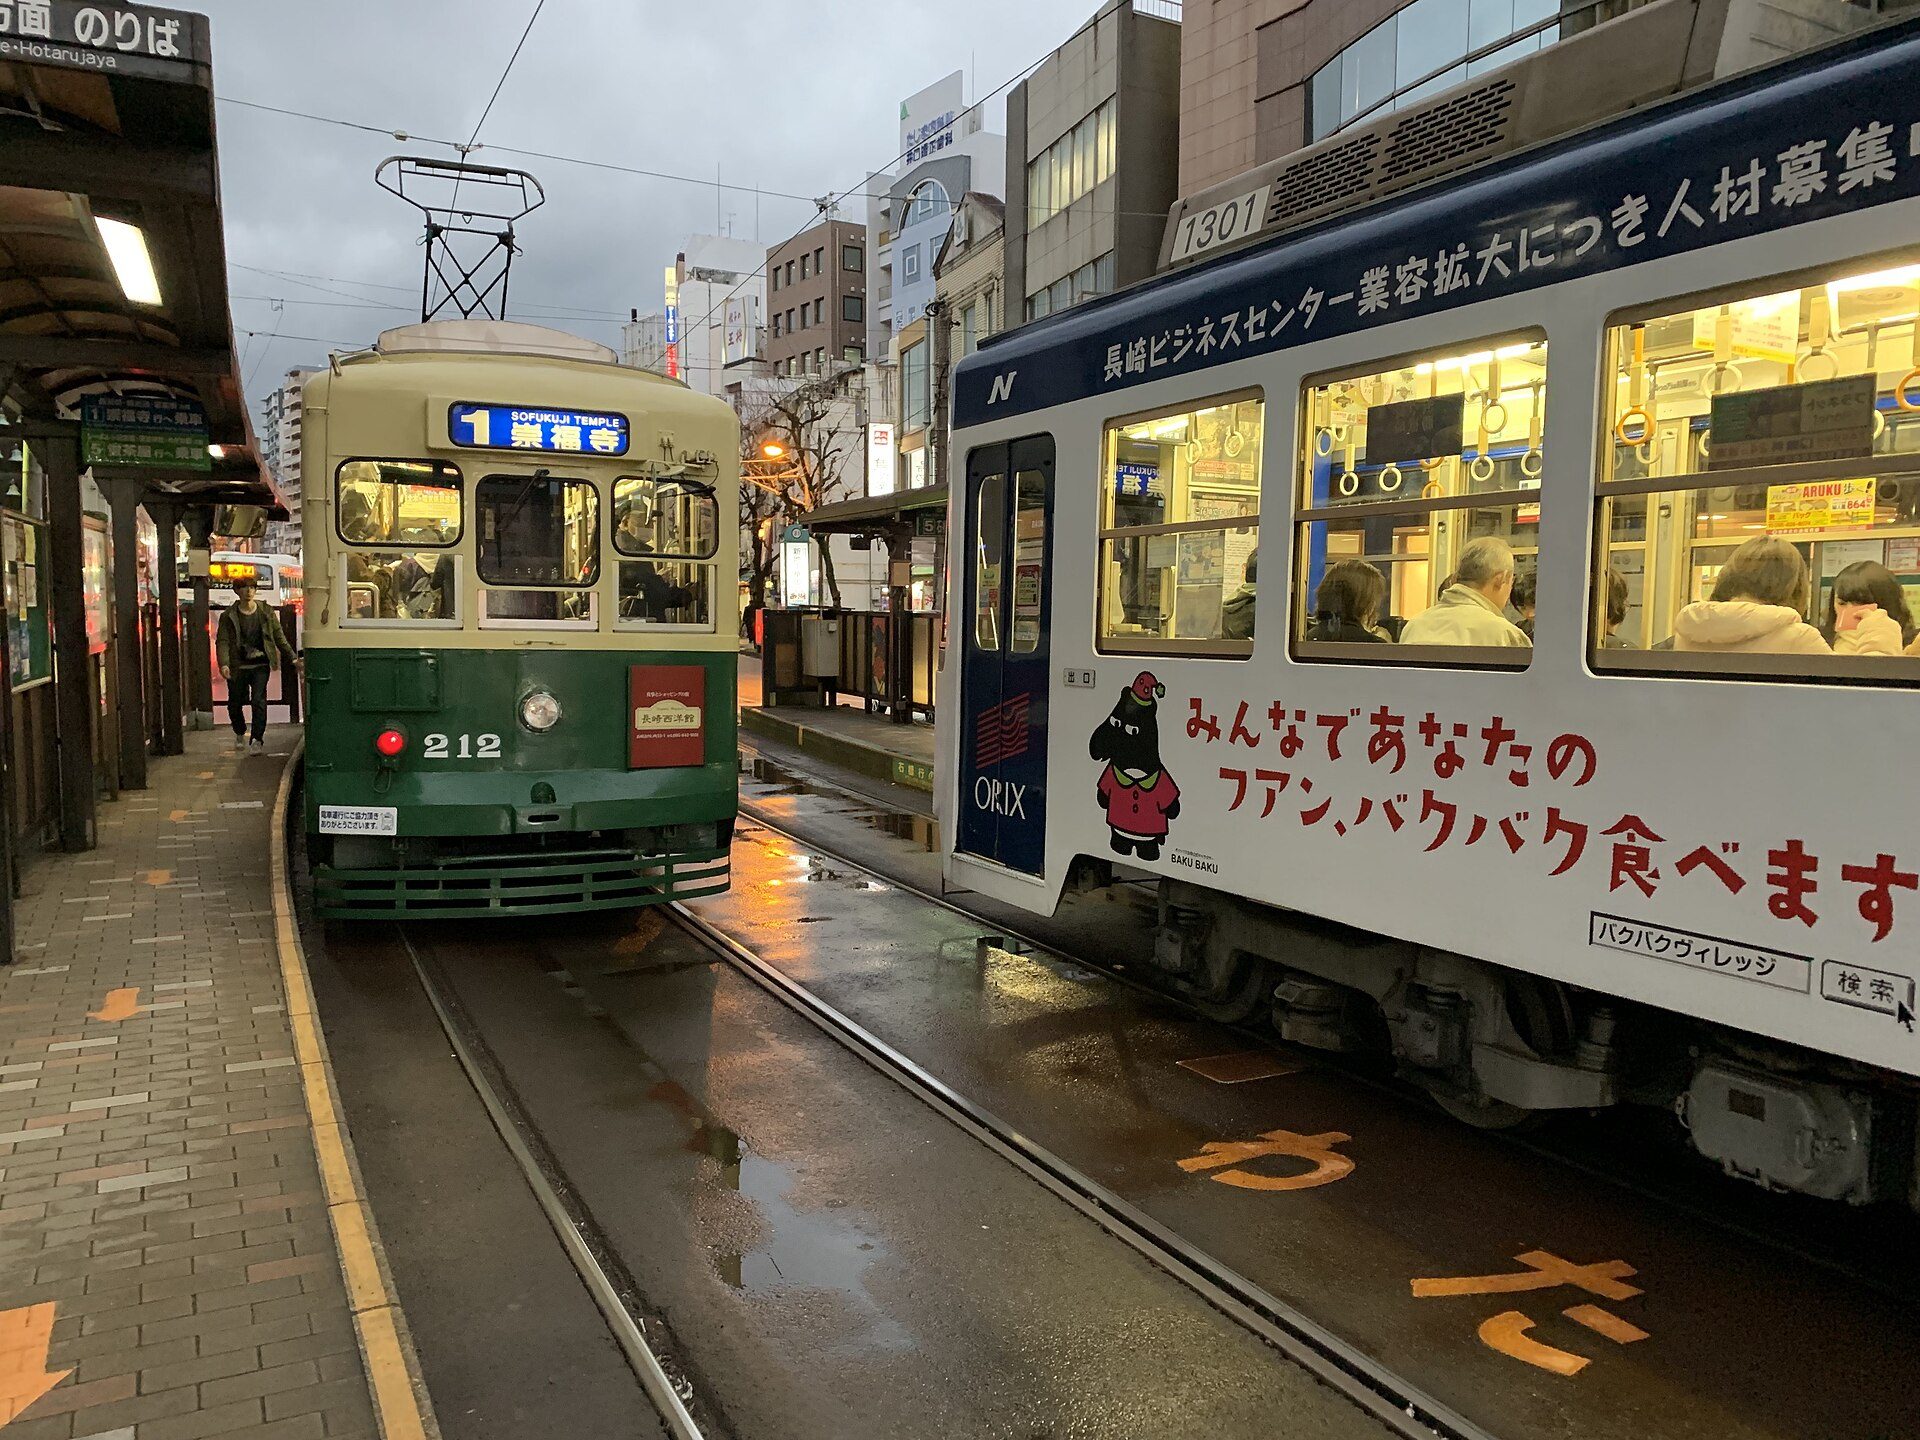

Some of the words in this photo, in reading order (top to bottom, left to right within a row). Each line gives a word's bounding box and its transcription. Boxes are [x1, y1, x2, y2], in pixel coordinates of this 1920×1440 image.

[74, 7, 180, 56] のりば
[1184, 193, 1257, 254] 1301
[460, 409, 490, 445] 1
[511, 411, 570, 424] SOFUKUJI
[573, 415, 620, 428] TEMPLE
[511, 422, 619, 453] 崇福寺
[1802, 483, 1841, 498] ARUKU
[1067, 671, 1090, 684] 出口
[423, 733, 501, 758] 212
[1186, 697, 1598, 788] みんなであなたの
[974, 776, 1026, 820] ORIX
[1171, 853, 1193, 868] BAKU
[1195, 859, 1218, 874] BAKU
[1598, 921, 1777, 977] バクバクヴィレッジ
[1837, 970, 1896, 1004] 検索
